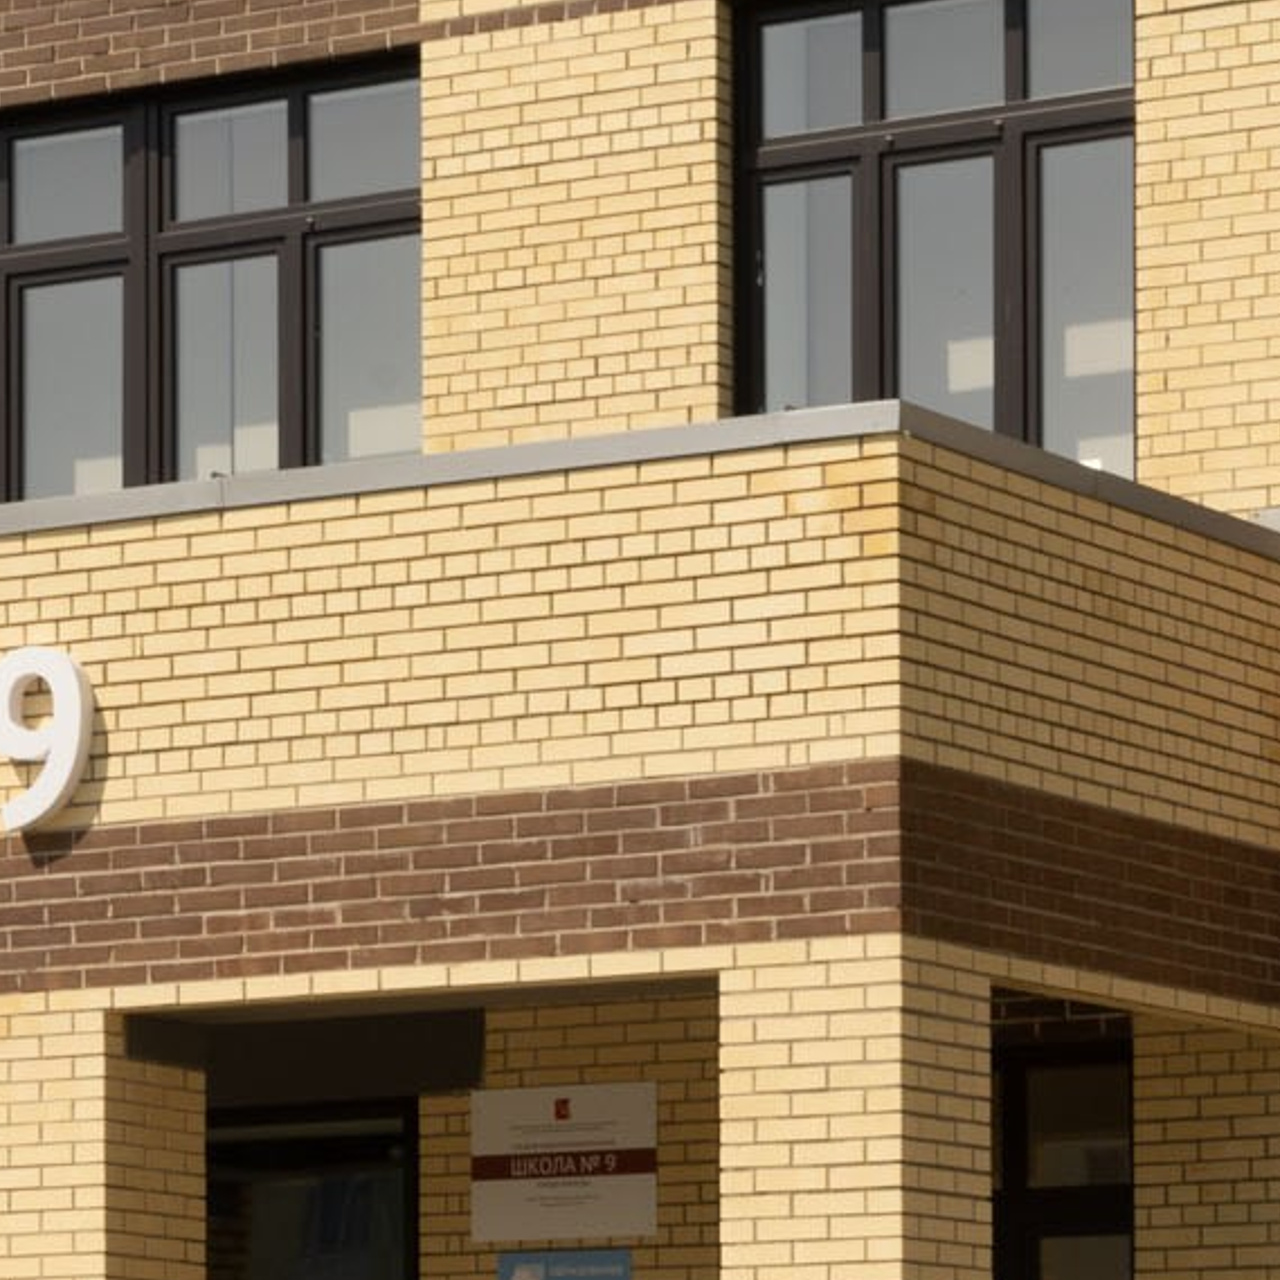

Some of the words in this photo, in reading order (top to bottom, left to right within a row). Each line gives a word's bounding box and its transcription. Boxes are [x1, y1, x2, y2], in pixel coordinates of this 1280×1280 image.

[511, 1156, 576, 1176] ШКОЛА
[580, 1156, 601, 1172] №
[605, 1154, 617, 1171] 9
